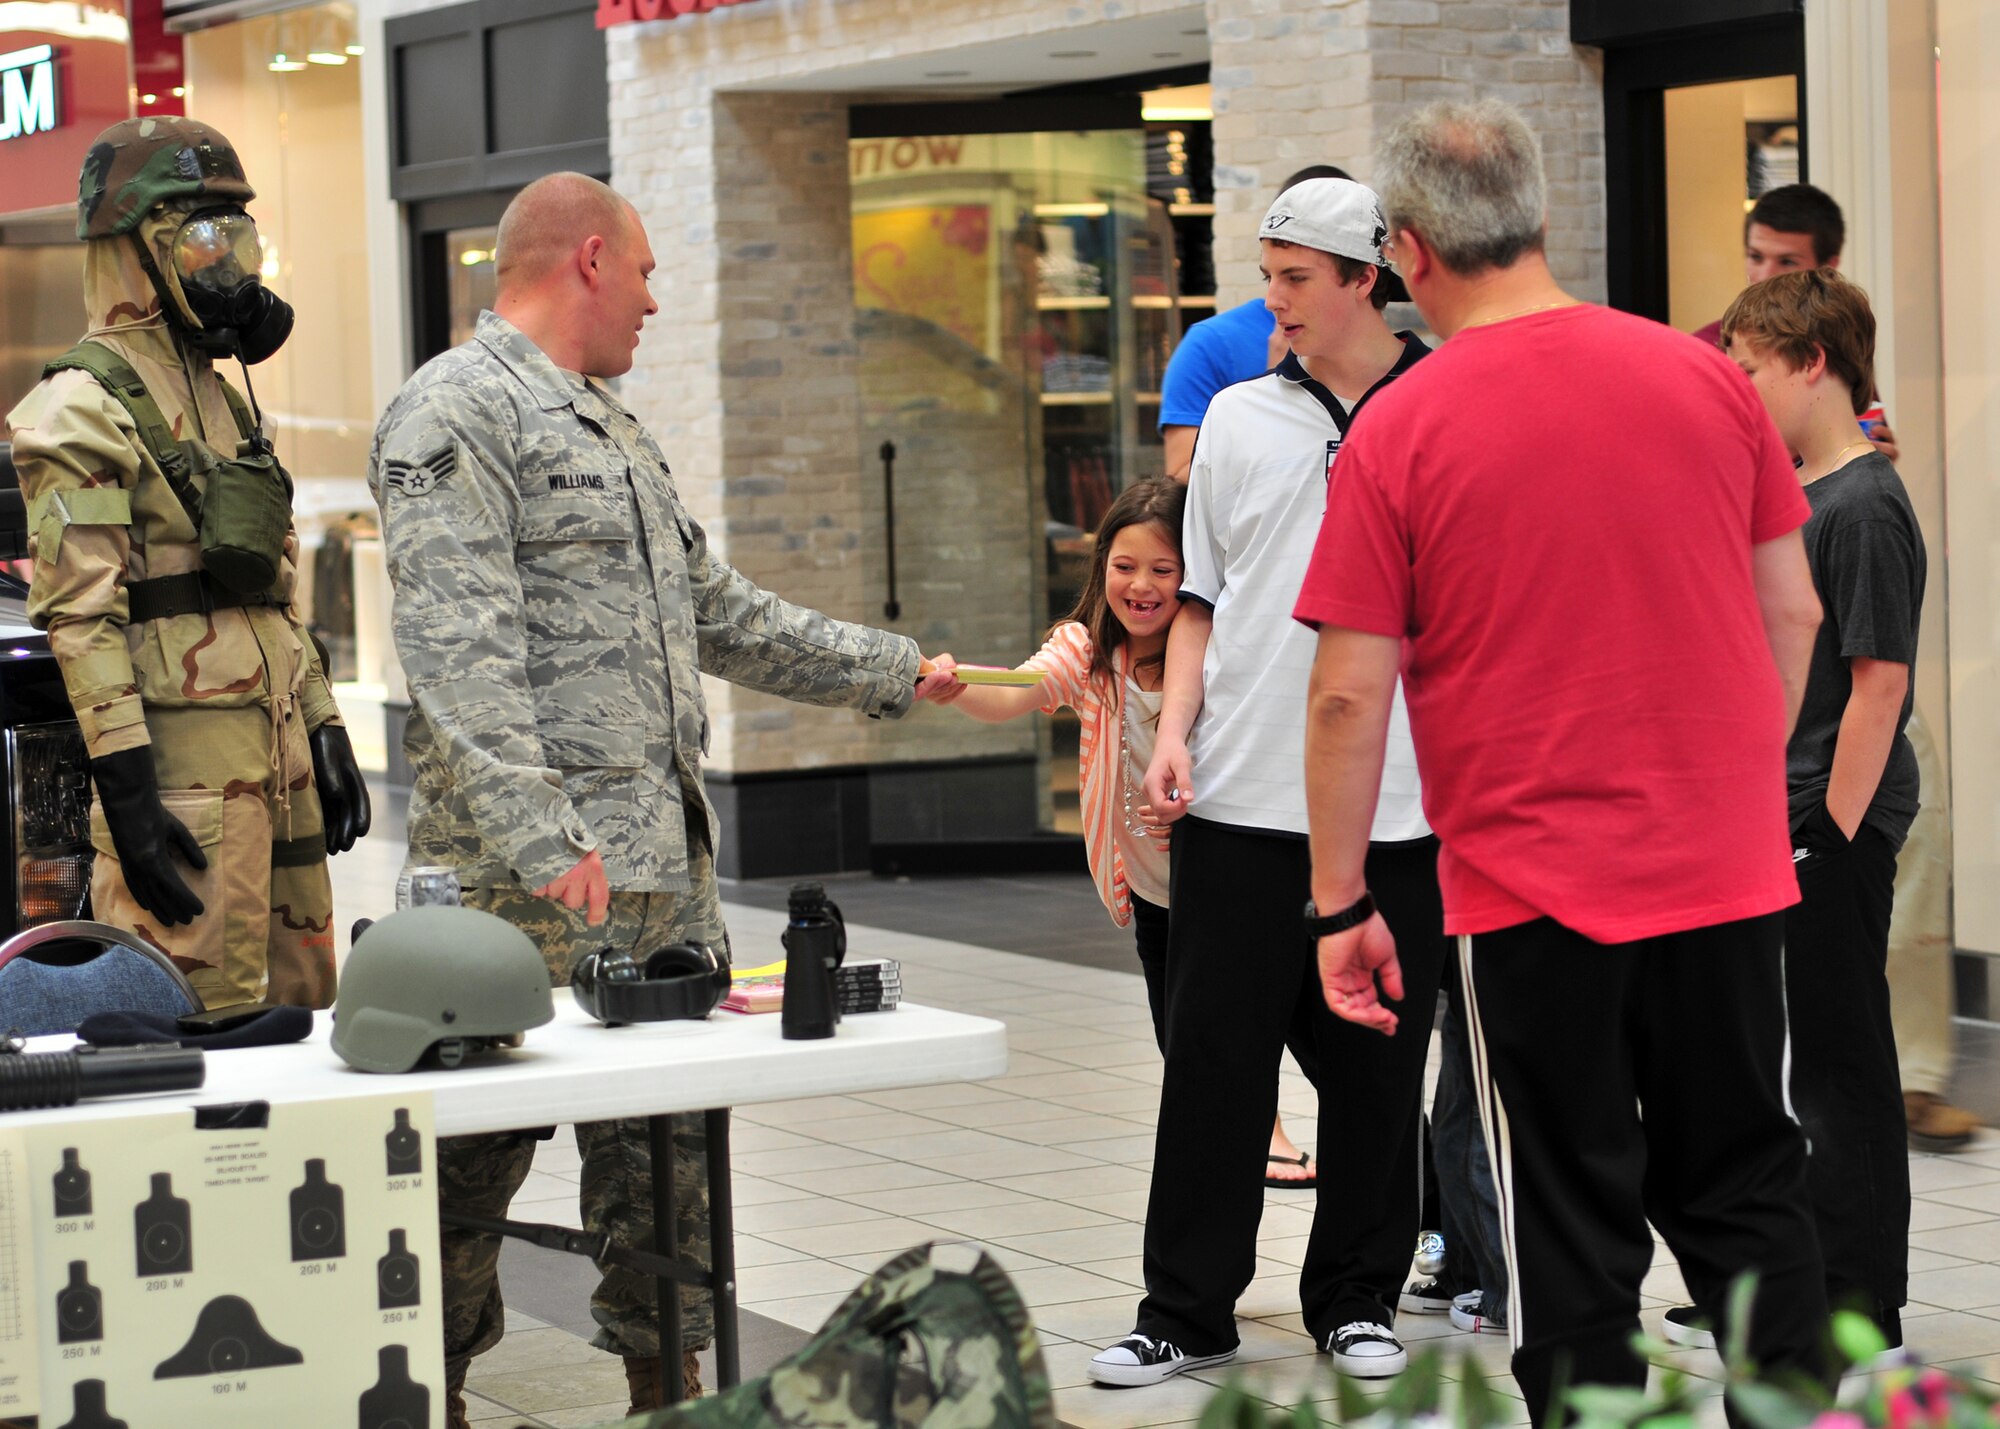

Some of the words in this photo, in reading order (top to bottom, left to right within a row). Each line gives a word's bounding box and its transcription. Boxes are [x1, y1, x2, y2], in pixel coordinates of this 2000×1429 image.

[547, 474, 605, 490] WILLIAMS
[386, 1179, 407, 1192] 300
[412, 1178, 422, 1189] M
[55, 1222, 77, 1234] 300
[84, 1220, 95, 1231] M
[300, 1263, 321, 1276] 200
[326, 1262, 337, 1273] M
[145, 1279, 167, 1292] 200
[173, 1278, 184, 1289] M
[382, 1312, 402, 1324] 250
[408, 1310, 418, 1321] M
[62, 1347, 84, 1360] 250
[90, 1345, 101, 1356] M
[212, 1383, 231, 1394] 100
[235, 1381, 246, 1392] M
